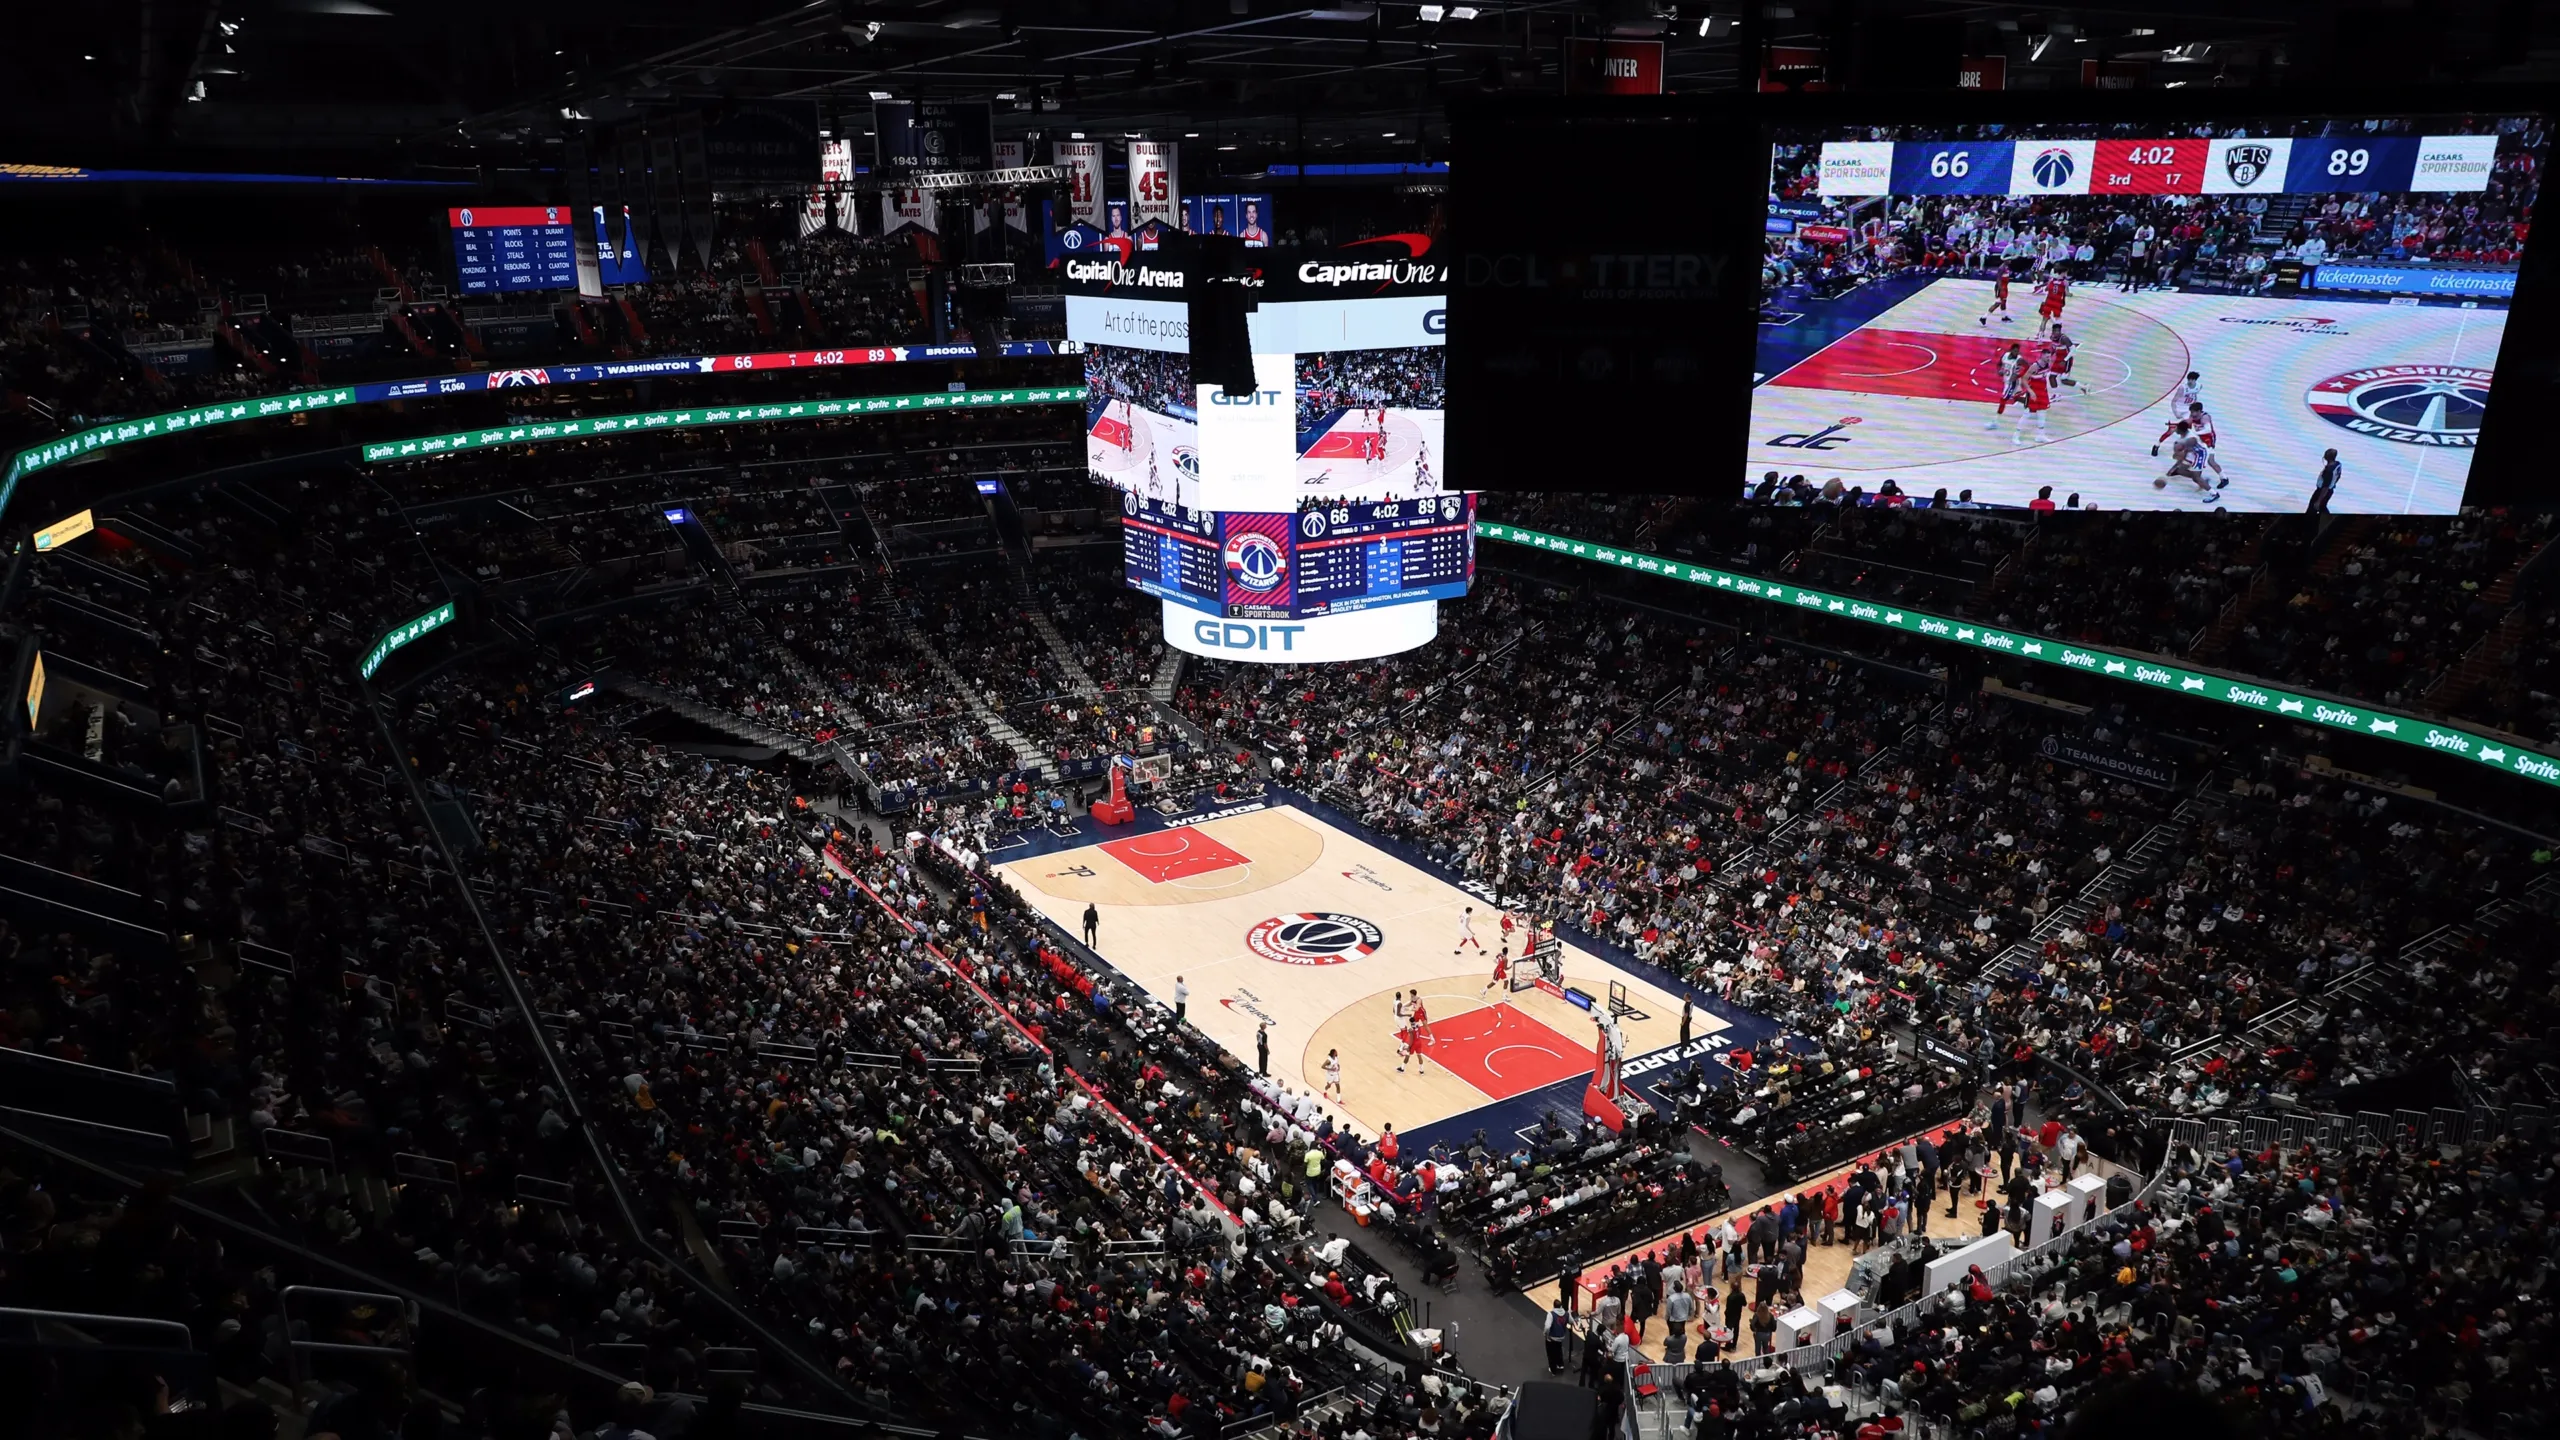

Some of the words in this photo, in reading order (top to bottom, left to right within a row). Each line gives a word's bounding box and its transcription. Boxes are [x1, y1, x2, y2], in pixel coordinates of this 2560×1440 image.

[1060, 145, 1096, 156] BULLETS
[1136, 145, 1171, 156] BULLETS
[2128, 146, 2174, 165] 4:02
[2226, 146, 2272, 165] NETS
[2423, 154, 2463, 162] CAESARS
[892, 157, 918, 166] 1943
[1071, 160, 1086, 169] WES
[1145, 160, 1161, 168] PHIL
[1825, 159, 1861, 167] CAESARS
[1930, 152, 1969, 178] 66
[2327, 149, 2369, 176] 89
[2420, 162, 2488, 173] SPORTSBOOK
[1823, 167, 1886, 178] SPORTSBOOK
[2108, 173, 2131, 186] 3rd
[2165, 173, 2182, 186] 17
[1138, 171, 1168, 202] 45
[545, 228, 564, 236] DURANT
[504, 240, 524, 248] BLOCKS
[546, 240, 567, 248] CLAXTON
[504, 263, 531, 271] REBOUNDS
[467, 281, 486, 289] MORRIS
[512, 275, 531, 283] ASSISTS
[1137, 265, 1184, 289] Arena
[2316, 270, 2403, 286] ticketmaster
[1105, 311, 1121, 333] Art
[1124, 311, 1135, 333] of
[1137, 313, 1158, 336] the
[734, 356, 752, 369] 66
[813, 351, 844, 365] 4:02
[868, 349, 886, 362] 89
[607, 361, 690, 374] WASHINGTON
[440, 382, 466, 393] $4,060
[1210, 390, 1281, 406] GDIT
[25, 454, 39, 470] Sprite
[54, 444, 67, 460] Sprite
[85, 434, 96, 449] Sprite
[118, 426, 138, 440] Sprite
[167, 416, 185, 431] Sprite
[205, 409, 224, 423] Sprite
[260, 401, 282, 414] Sprite
[307, 395, 328, 408] Sprite
[369, 446, 394, 459] Sprite
[422, 439, 445, 452] Sprite
[481, 432, 503, 444] Sprite
[531, 426, 556, 438] Sprite
[594, 420, 617, 432] Sprite
[644, 415, 668, 426] Sprite
[706, 411, 730, 422] Sprite
[758, 408, 782, 418] Sprite
[818, 403, 841, 414] Sprite
[867, 400, 889, 410] Sprite
[923, 396, 945, 406] Sprite
[970, 394, 993, 404] Sprite
[1028, 392, 1050, 401] Sprite
[1161, 501, 1177, 517] 4:02
[1418, 498, 1436, 515] 89
[1443, 498, 1461, 508] NETS
[1187, 508, 1199, 523] 89
[1330, 507, 1349, 525] 66
[1372, 503, 1399, 519] 4:02
[1236, 533, 1280, 551] WASHINGTON
[1379, 536, 1387, 548] 3
[1240, 572, 1280, 587] WIZARDS
[1244, 610, 1290, 619] SPORTSBOOK
[390, 631, 406, 649] Sprite
[422, 616, 436, 632] Sprite
[1194, 619, 1305, 651] GDIT
[1513, 531, 1530, 542] Sprite
[1550, 539, 1568, 550] Sprite
[1596, 549, 1615, 561] Sprite
[1637, 558, 1658, 570] Sprite
[1689, 570, 1712, 582] Sprite
[1737, 580, 1760, 593] Sprite
[1796, 592, 1822, 606] Sprite
[1850, 604, 1878, 618] Sprite
[1919, 619, 1948, 634] Sprite
[1982, 633, 2013, 648] Sprite
[2061, 650, 2095, 667] Sprite
[2134, 666, 2171, 683] Sprite
[2227, 687, 2268, 705] Sprite
[2313, 706, 2357, 725] Sprite
[2425, 730, 2469, 751] Sprite
[2514, 756, 2560, 779] Sprite
[1164, 802, 1266, 828] WIZARDS
[1327, 914, 1381, 943] WIZARDS
[1250, 927, 1316, 965] WASHINGTON
